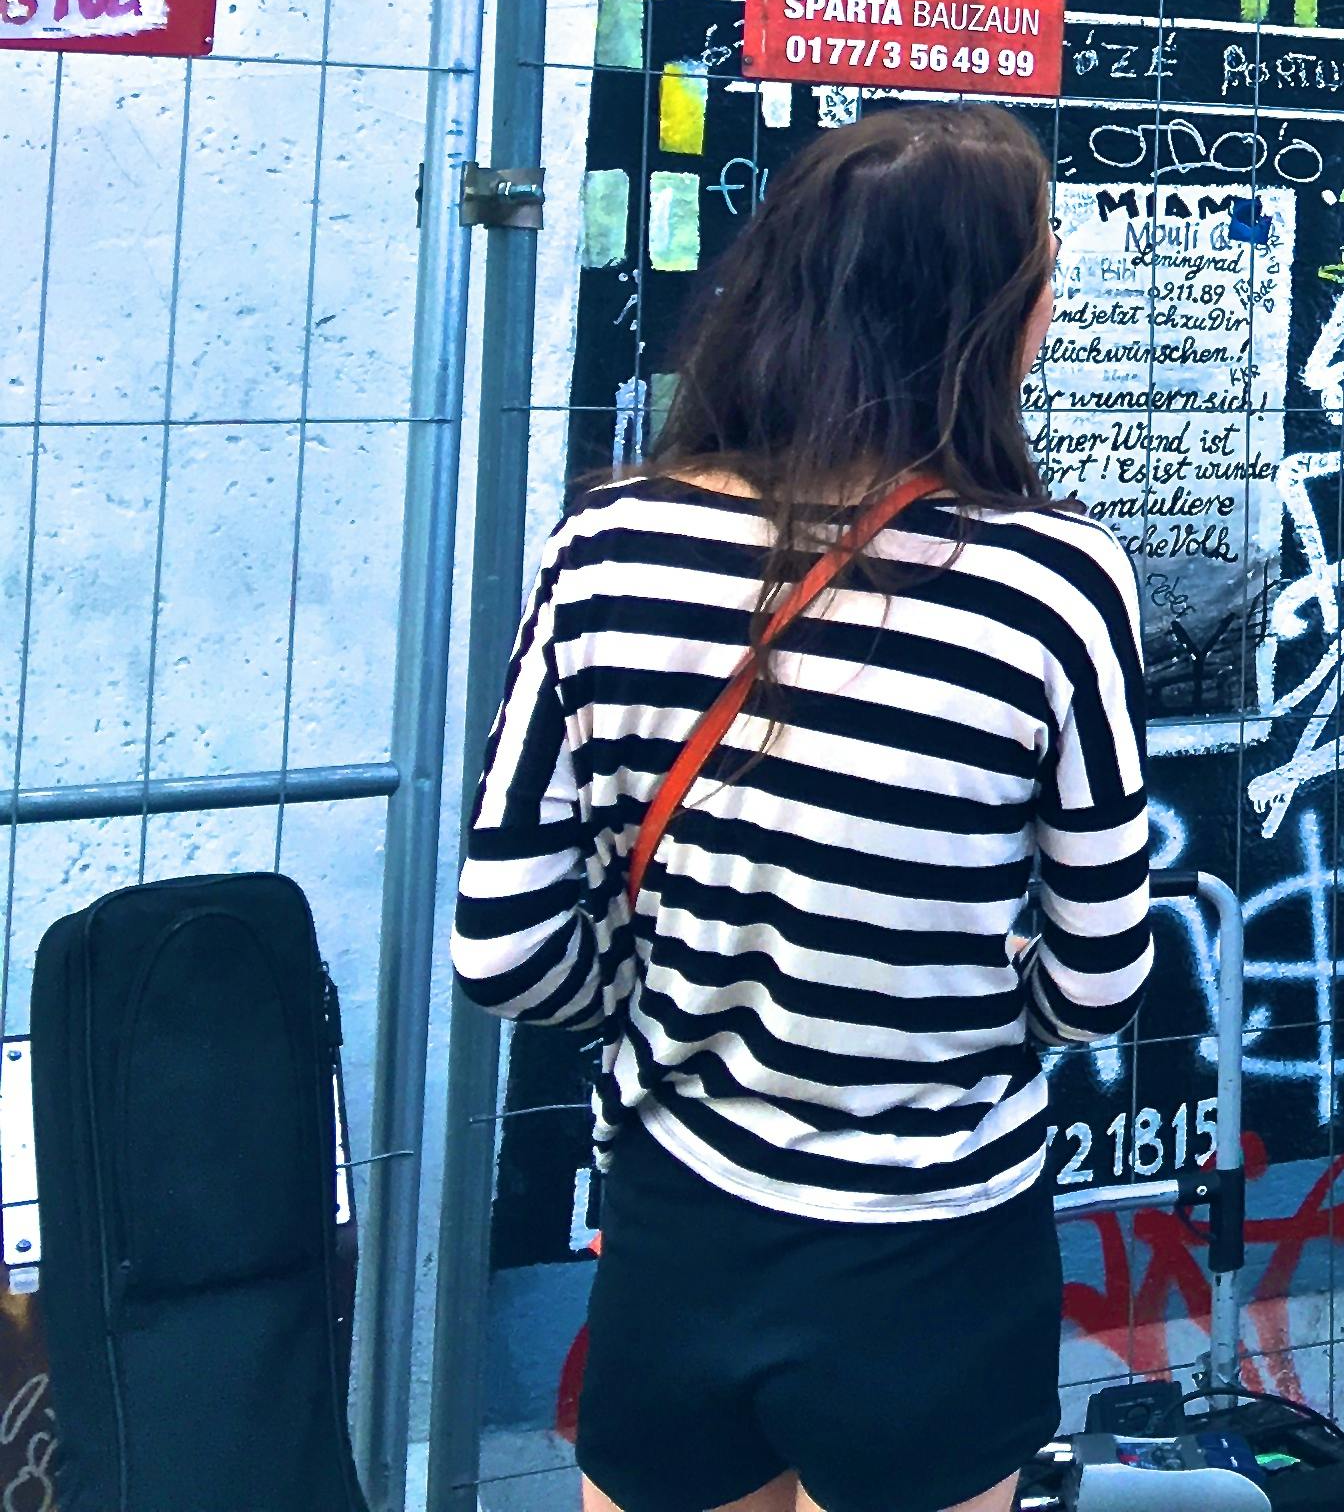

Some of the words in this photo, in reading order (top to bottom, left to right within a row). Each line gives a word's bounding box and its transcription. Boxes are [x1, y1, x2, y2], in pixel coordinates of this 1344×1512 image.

[913, 0, 1041, 36] BAUZAUN
[1096, 188, 1238, 223] MIAM
[1131, 249, 1243, 281] Leningrad
[1207, 307, 1251, 332] Dir
[1068, 386, 1198, 410] wundern
[1110, 420, 1191, 454] Wand
[1199, 424, 1241, 455] ist
[1168, 523, 1239, 563] Volk
